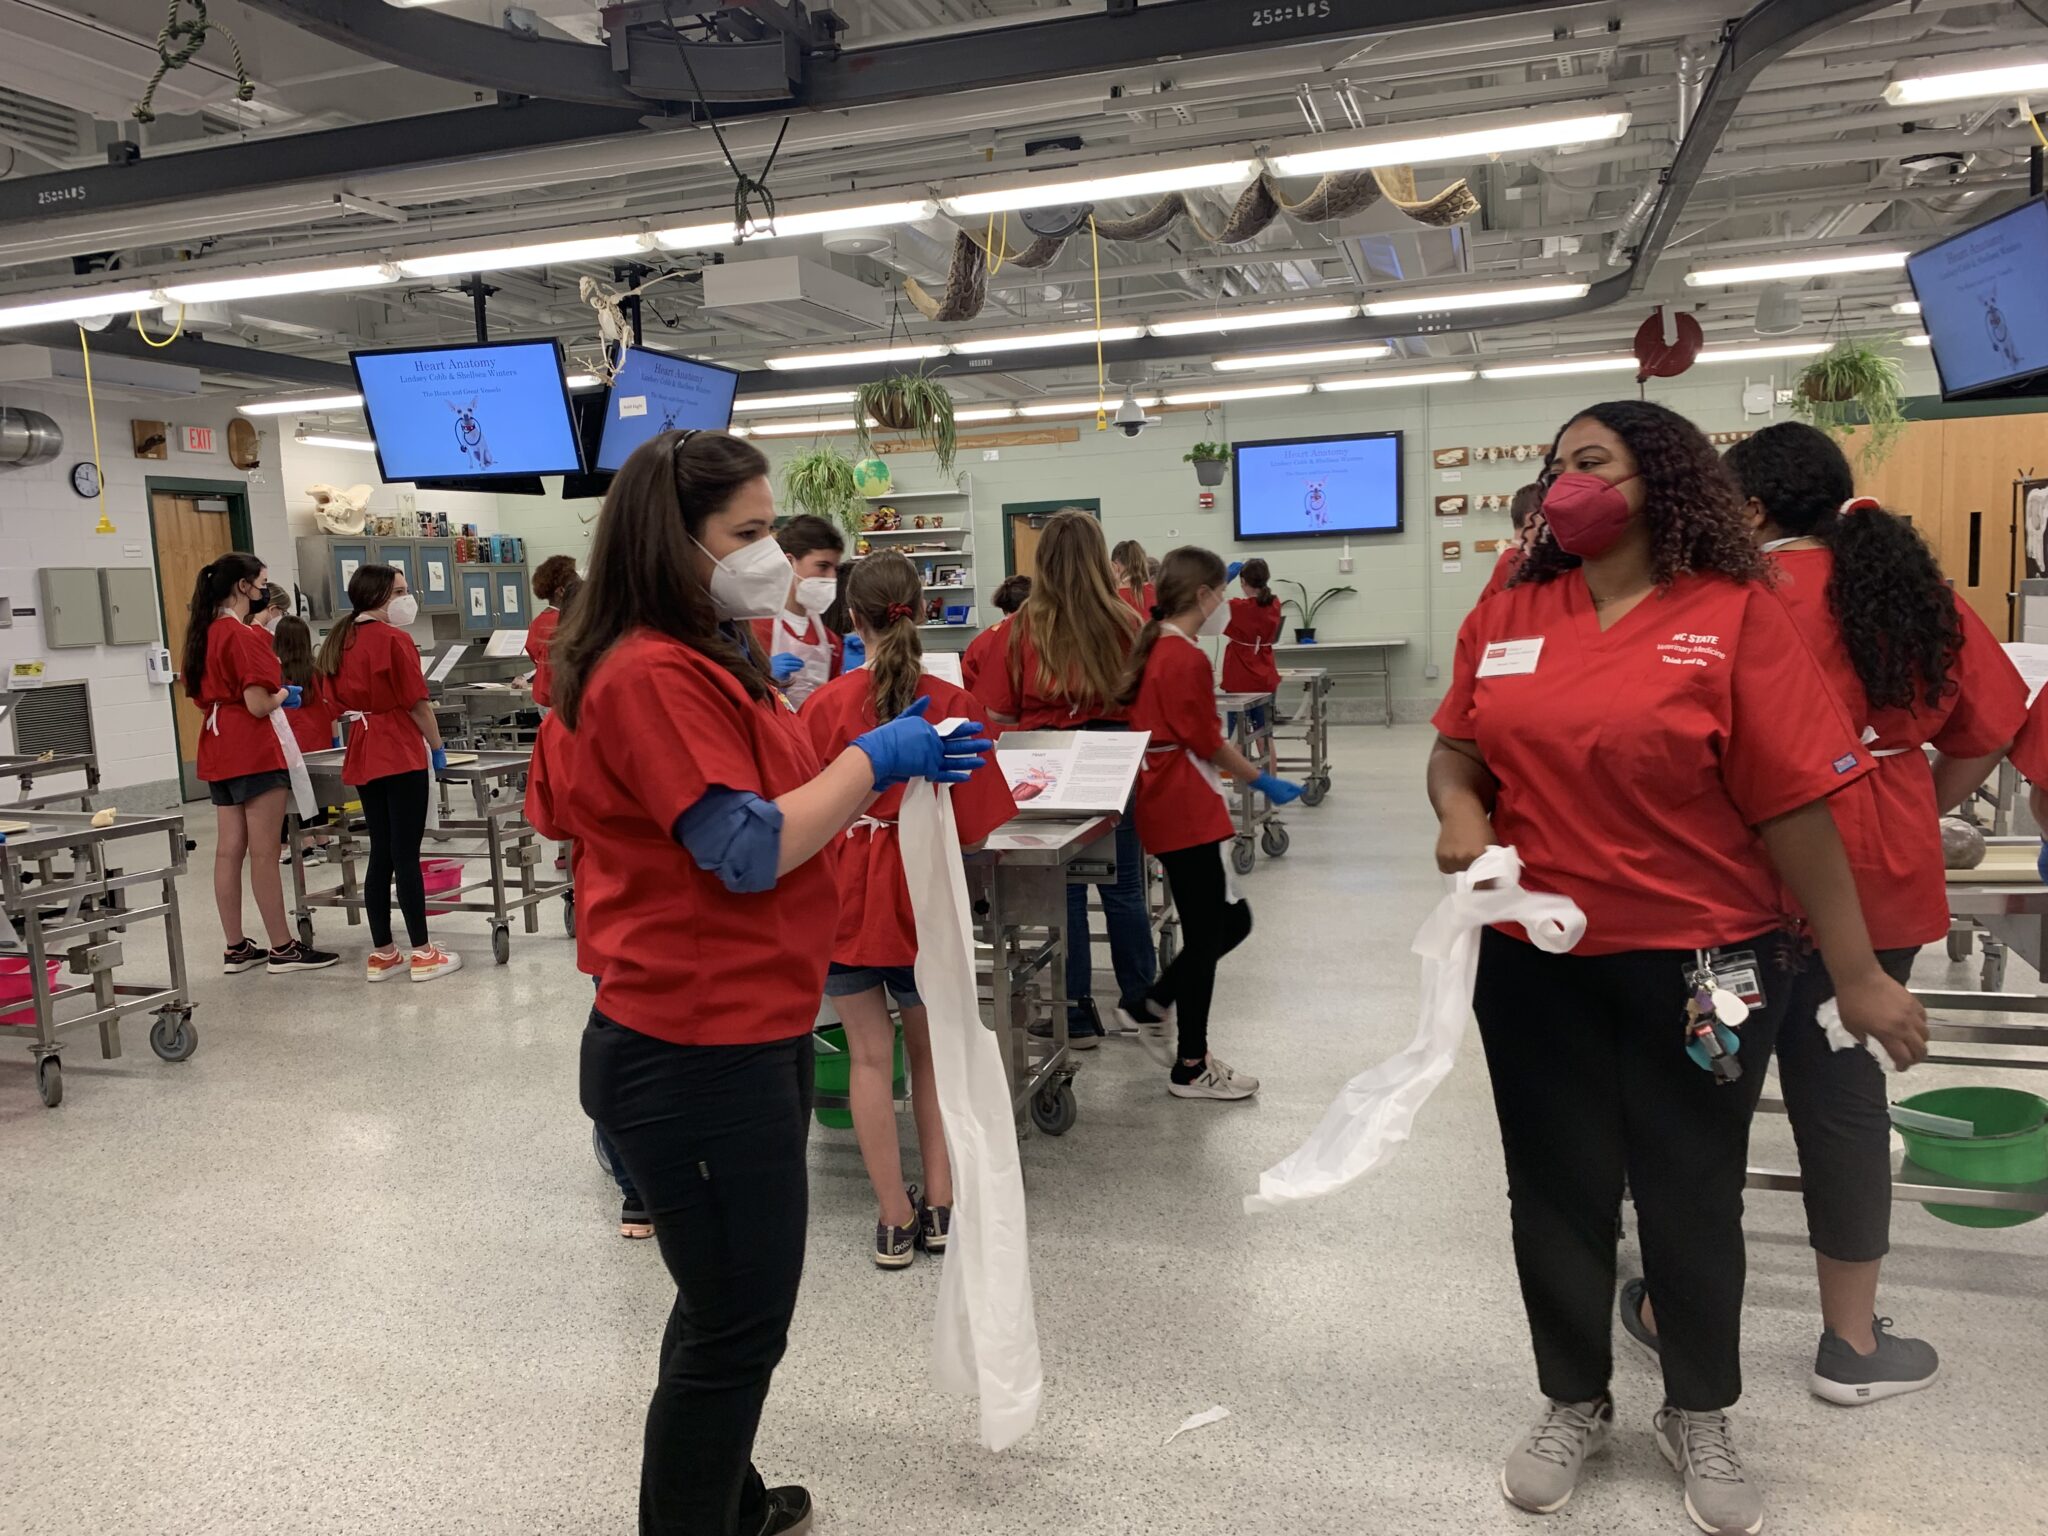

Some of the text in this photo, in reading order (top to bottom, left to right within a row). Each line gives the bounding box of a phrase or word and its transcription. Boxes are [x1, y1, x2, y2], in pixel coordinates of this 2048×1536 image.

[414, 359, 496, 372] Heart Anatomy
[654, 362, 674, 377] Heart
[189, 428, 212, 449] EXIT
[1284, 448, 1349, 459] Heart Anatomy
[1672, 633, 1719, 644] NC STATE
[1692, 646, 1726, 660] Medicine
[1662, 655, 1682, 664] Think
[1696, 658, 1707, 667] Do
